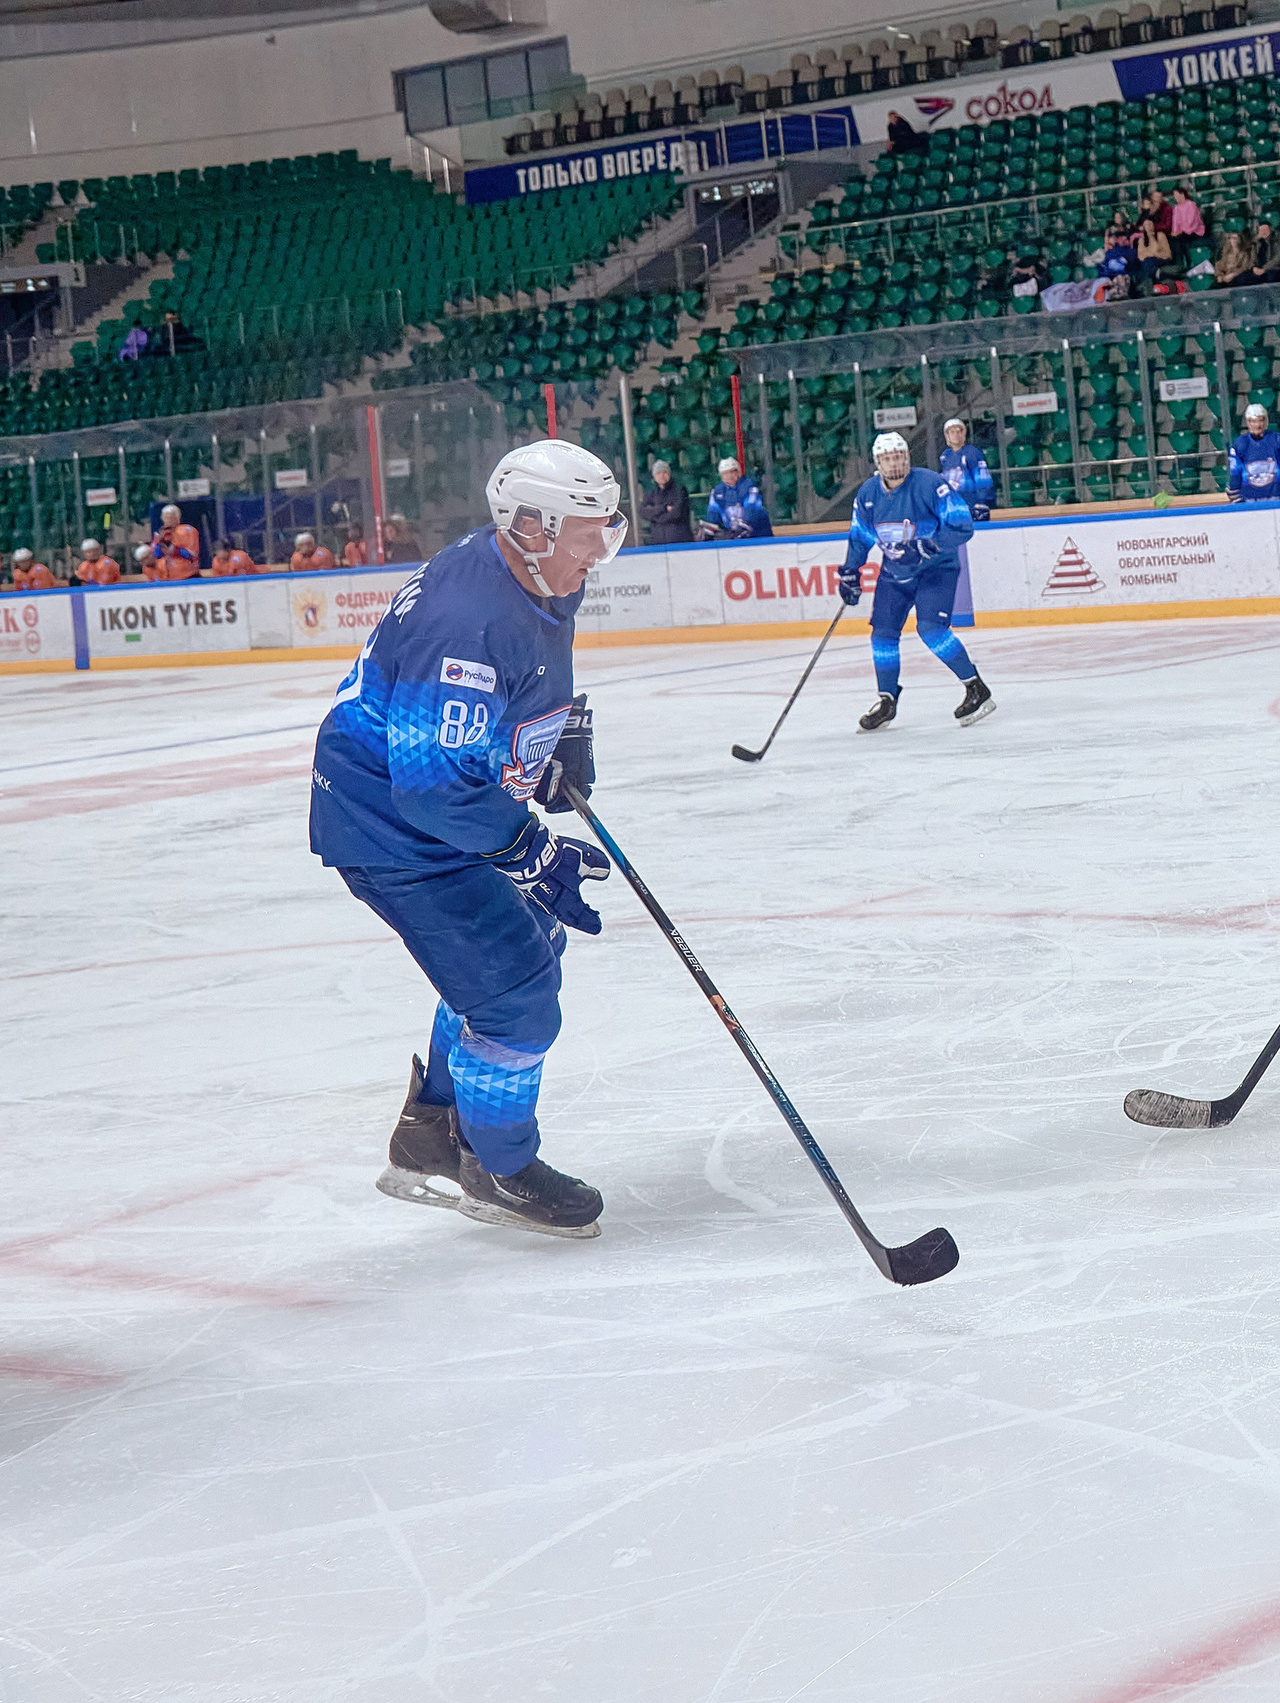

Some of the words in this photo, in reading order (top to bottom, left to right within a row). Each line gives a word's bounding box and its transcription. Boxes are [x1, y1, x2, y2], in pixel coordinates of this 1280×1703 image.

[516, 157, 598, 193] ТОЛЬКО
[1117, 532, 1209, 551] НОВОАНГАРСКИЙ
[1118, 550, 1216, 569] ОБОГАТИТЕЛЬНЫЙ
[1120, 572, 1178, 586] КОМБИНАТ
[100, 605, 157, 632] IKON
[164, 599, 238, 627] TYRES
[338, 612, 381, 628] ХОККЕ
[674, 936, 703, 972] BAUER
